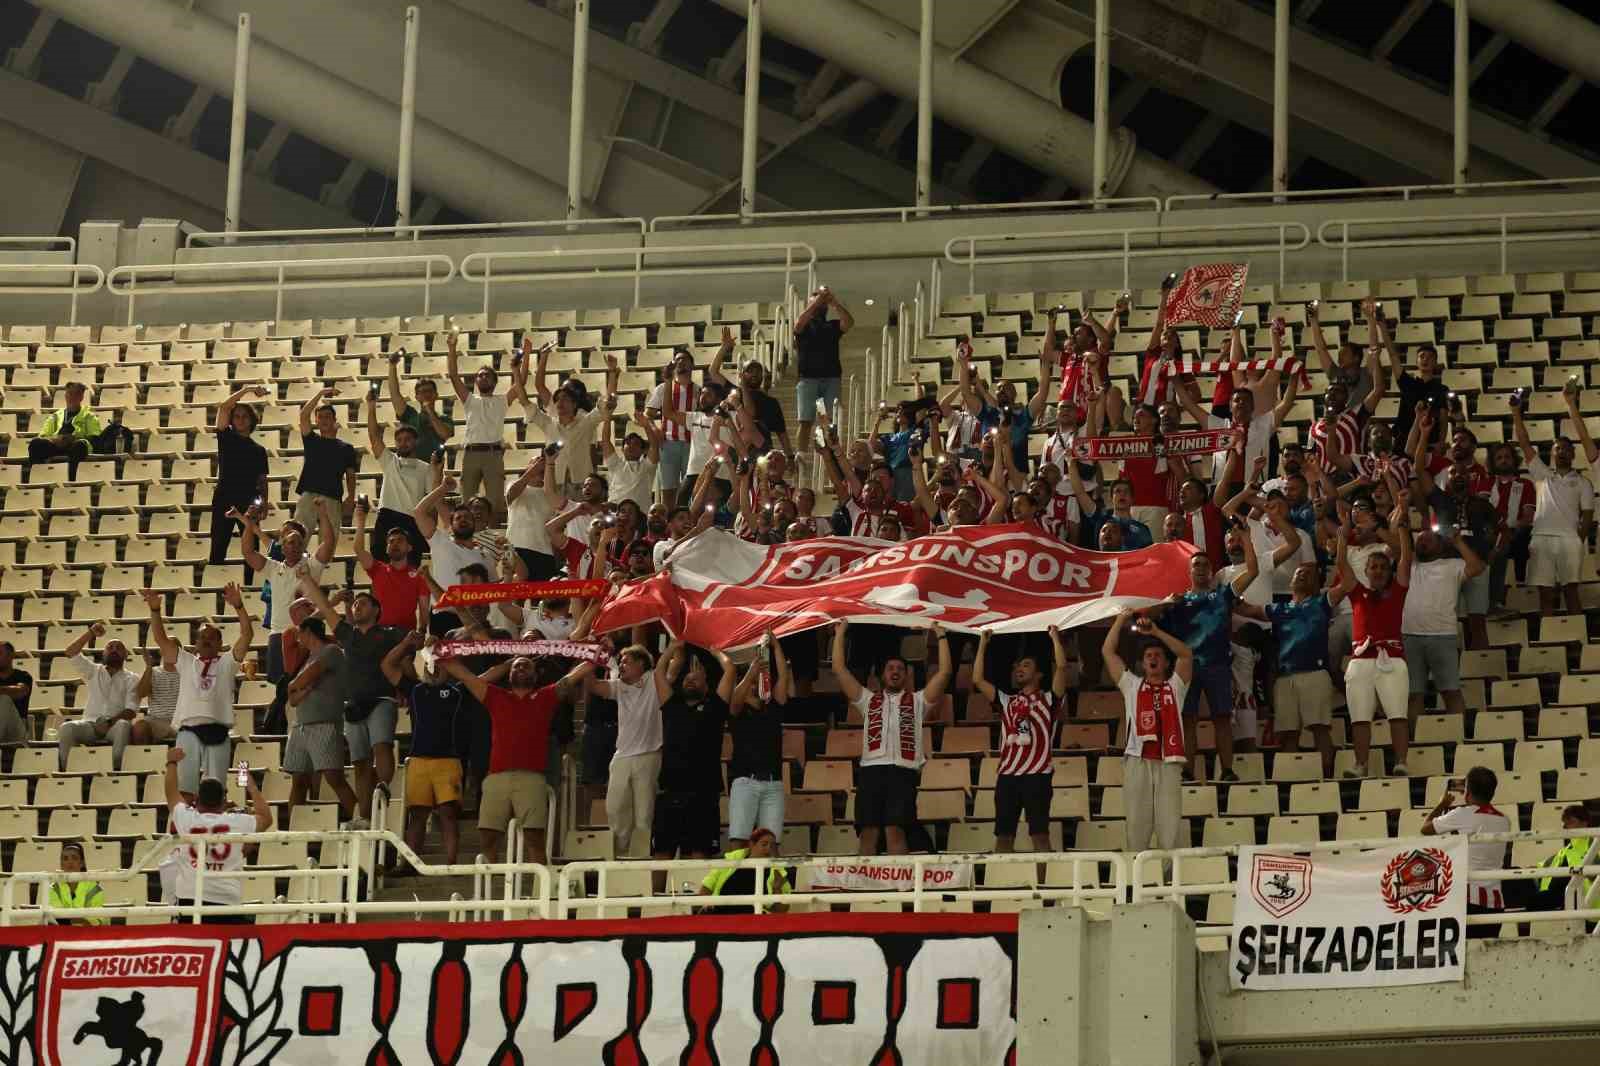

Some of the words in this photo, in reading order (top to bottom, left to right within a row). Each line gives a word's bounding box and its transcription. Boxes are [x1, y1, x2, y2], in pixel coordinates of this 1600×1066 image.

[848, 865, 954, 884] SAMSUNPOR
[1236, 917, 1460, 984] ŞEHZADELER
[64, 955, 203, 977] SAMSUNSPOR
